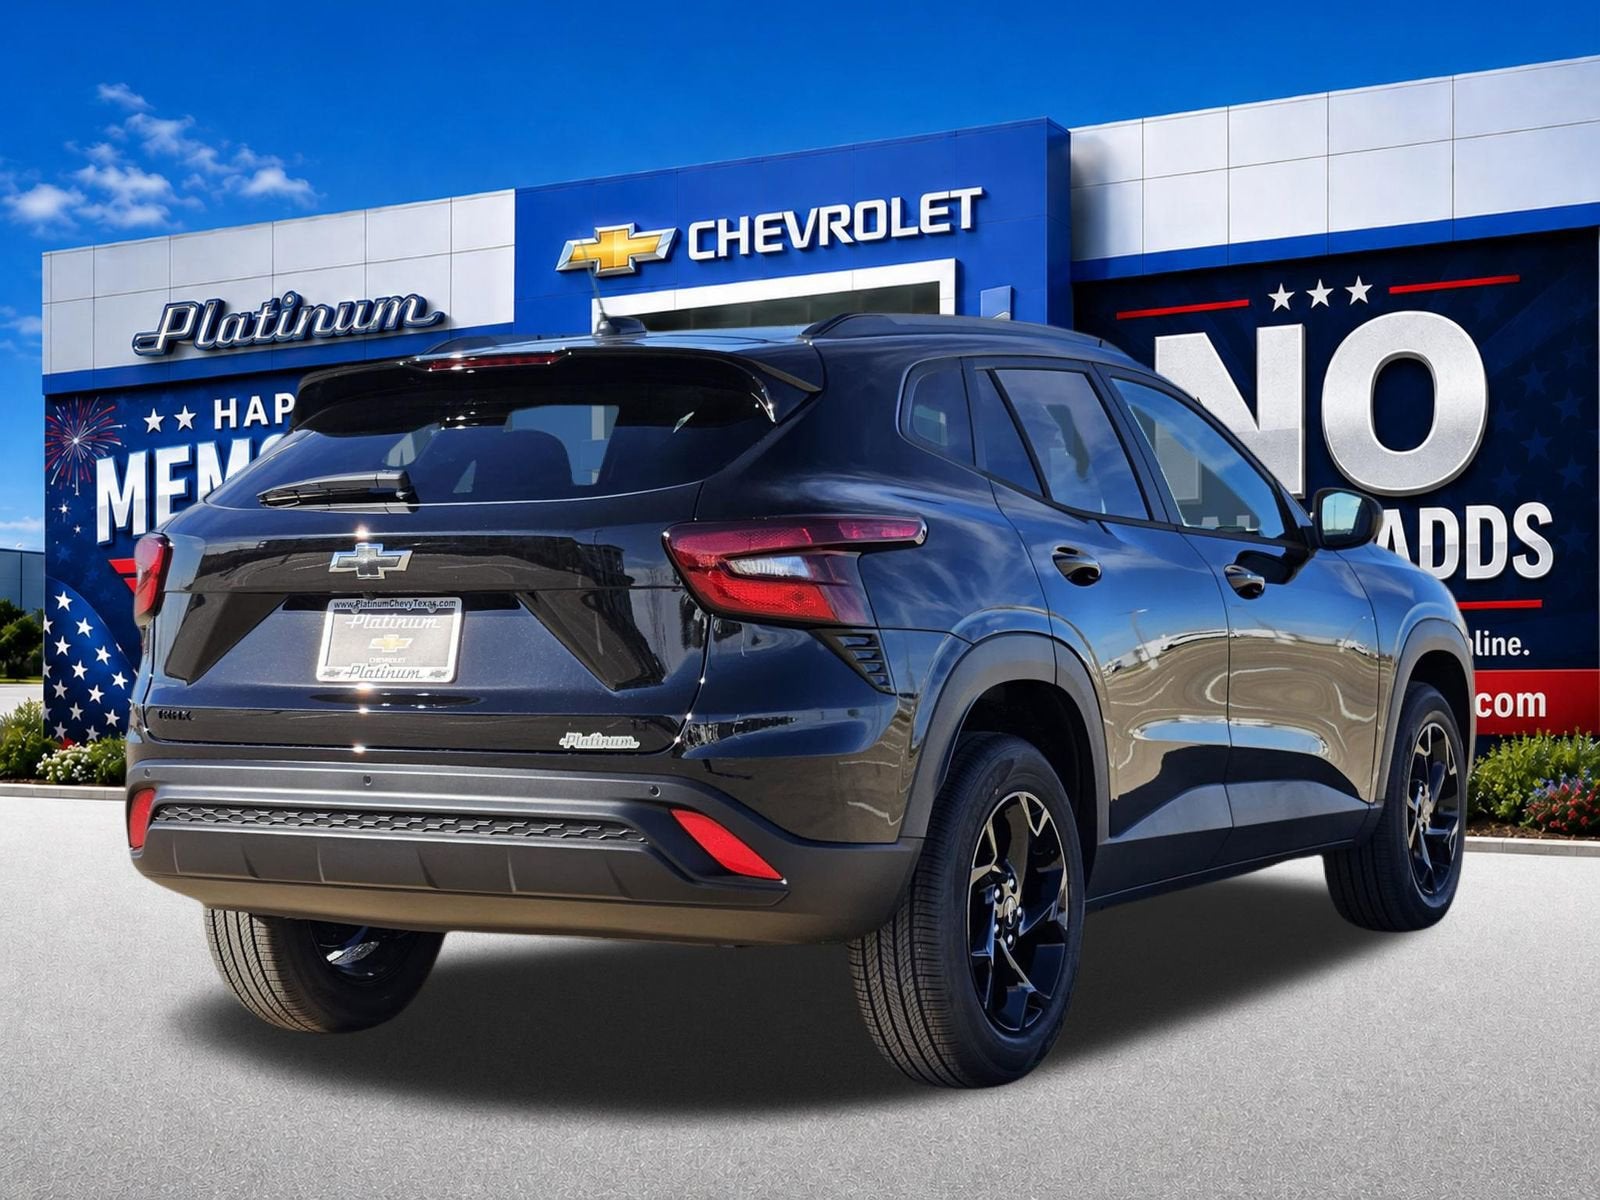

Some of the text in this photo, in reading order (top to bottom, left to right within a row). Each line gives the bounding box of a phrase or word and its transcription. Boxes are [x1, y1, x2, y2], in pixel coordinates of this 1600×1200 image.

[687, 186, 983, 262] CHEVROLET
[132, 291, 446, 356] Platinum
[1155, 310, 1488, 497] NO
[96, 433, 287, 543] MEM
[1375, 501, 1554, 580] ADDS
[334, 599, 457, 610] www.PlatinumChevyTexas.com
[346, 613, 441, 629] Platinum
[345, 664, 424, 679] Platinum
[558, 732, 641, 749] Platinum
